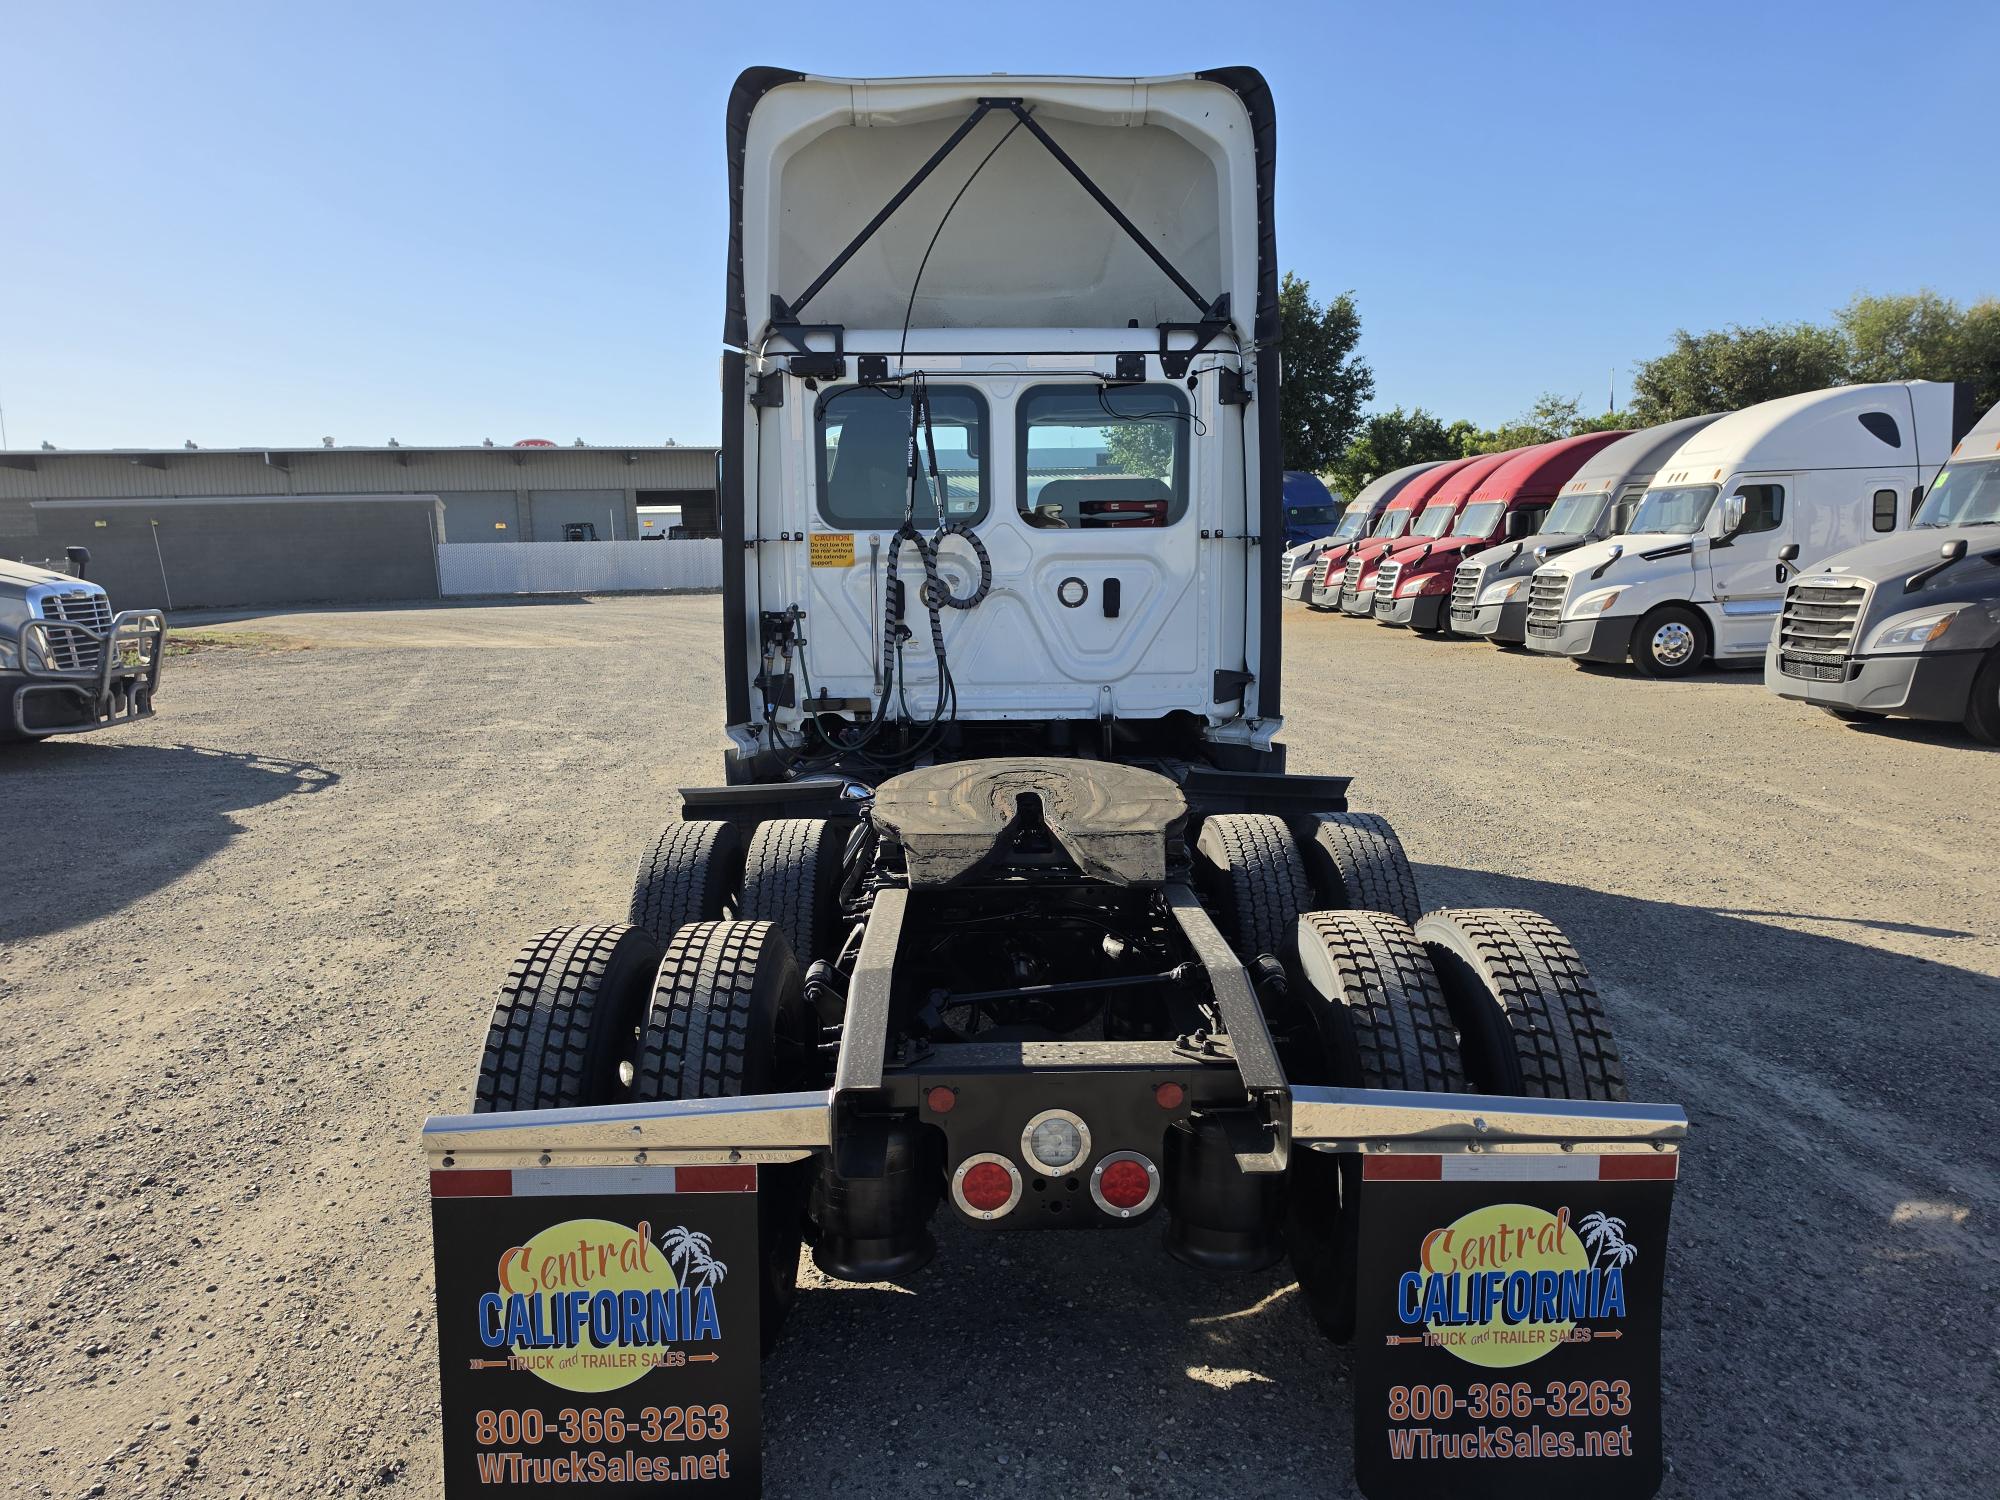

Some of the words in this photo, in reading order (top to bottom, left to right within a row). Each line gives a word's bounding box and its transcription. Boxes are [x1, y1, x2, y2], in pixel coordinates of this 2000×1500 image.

[498, 1220, 653, 1298] Central
[1420, 1206, 1571, 1278] Central
[1398, 1267, 1626, 1325] CALIFORNIA
[478, 1286, 721, 1348] CALIFORNIA
[1423, 1331, 1467, 1347] TRUCK
[1471, 1329, 1491, 1346] and
[1492, 1329, 1545, 1345] TRAILER
[1550, 1327, 1592, 1343] SALES
[507, 1354, 554, 1371] TRUCK
[558, 1352, 579, 1370] and
[581, 1353, 637, 1369] TRAILER
[641, 1351, 686, 1368] SALES
[1388, 1380, 1632, 1421] 800-366-3263
[475, 1404, 730, 1445] 800-366-3263
[1388, 1425, 1633, 1459] WTruckSales.net
[476, 1448, 730, 1484] WTruckSales.net
